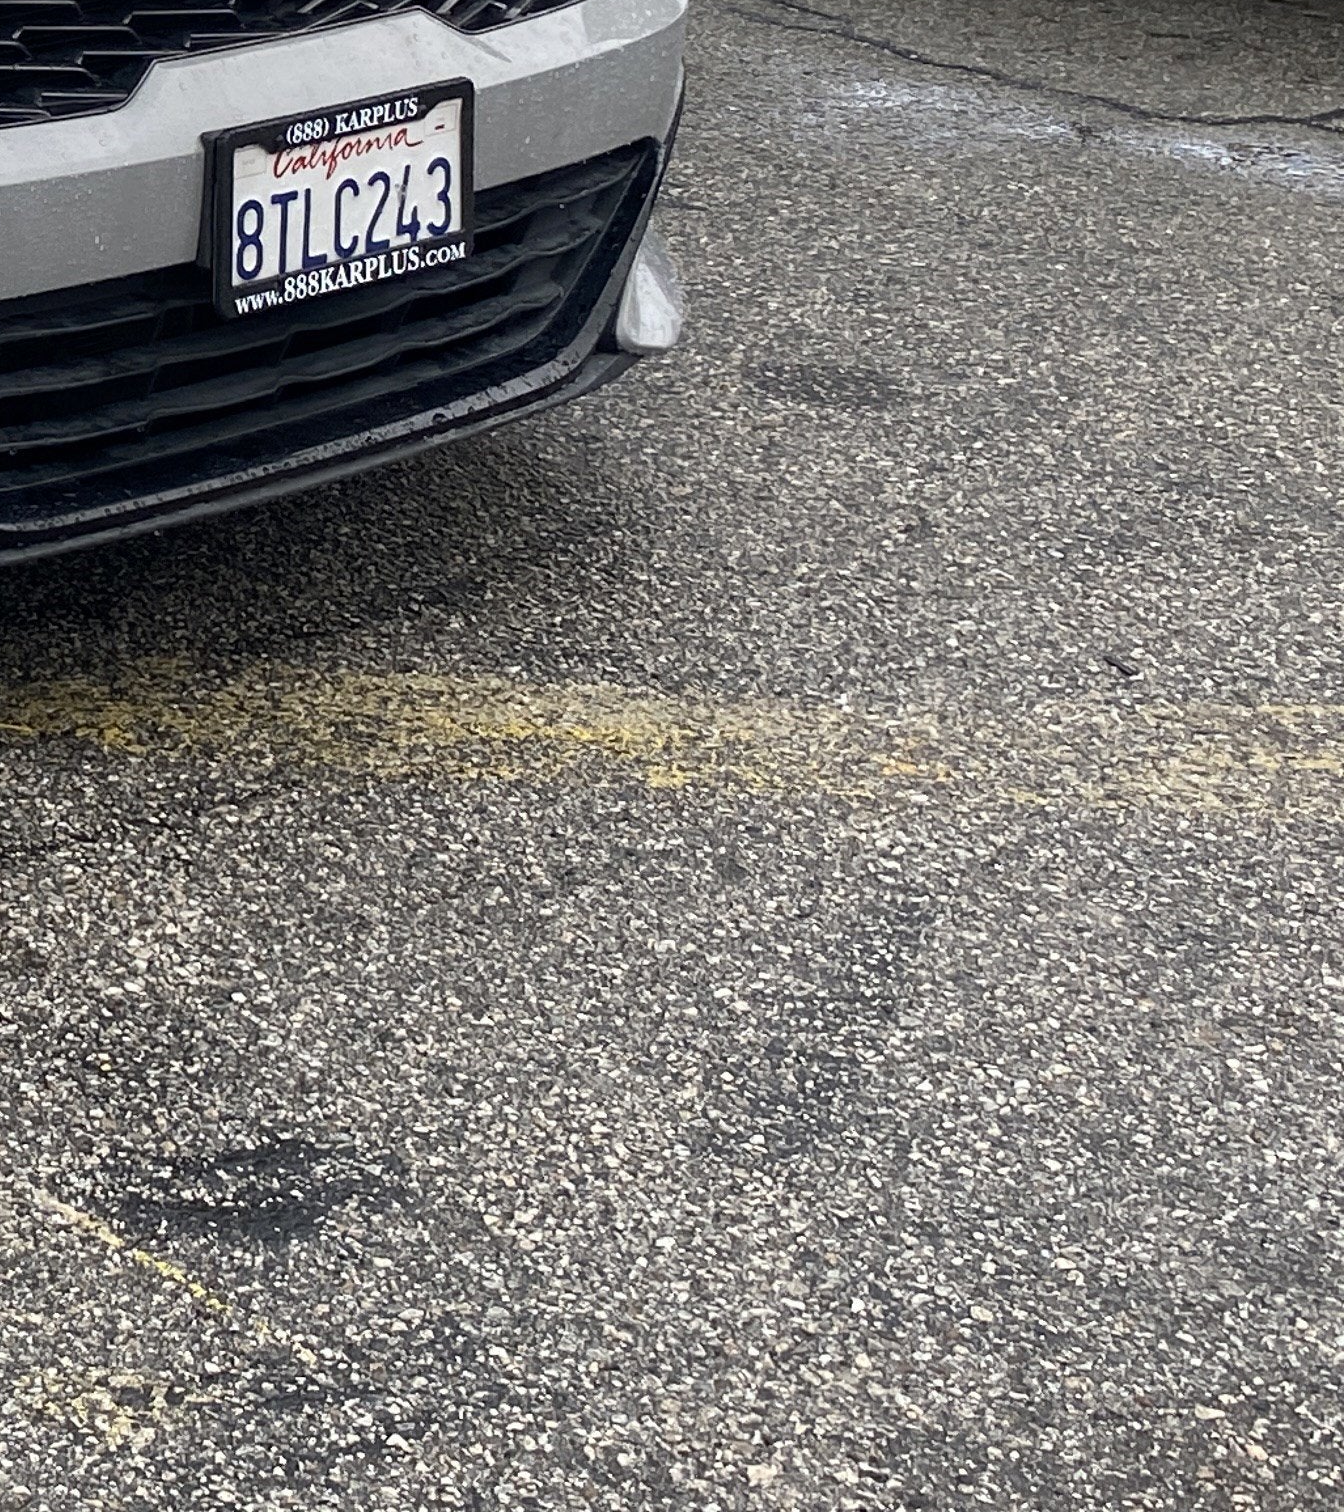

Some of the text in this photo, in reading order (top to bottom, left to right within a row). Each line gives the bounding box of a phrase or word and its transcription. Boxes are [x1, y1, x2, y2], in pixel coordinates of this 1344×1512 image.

[286, 97, 419, 145] (888) KARPLUS
[273, 127, 424, 180] California
[236, 157, 452, 281] 8TLC243
